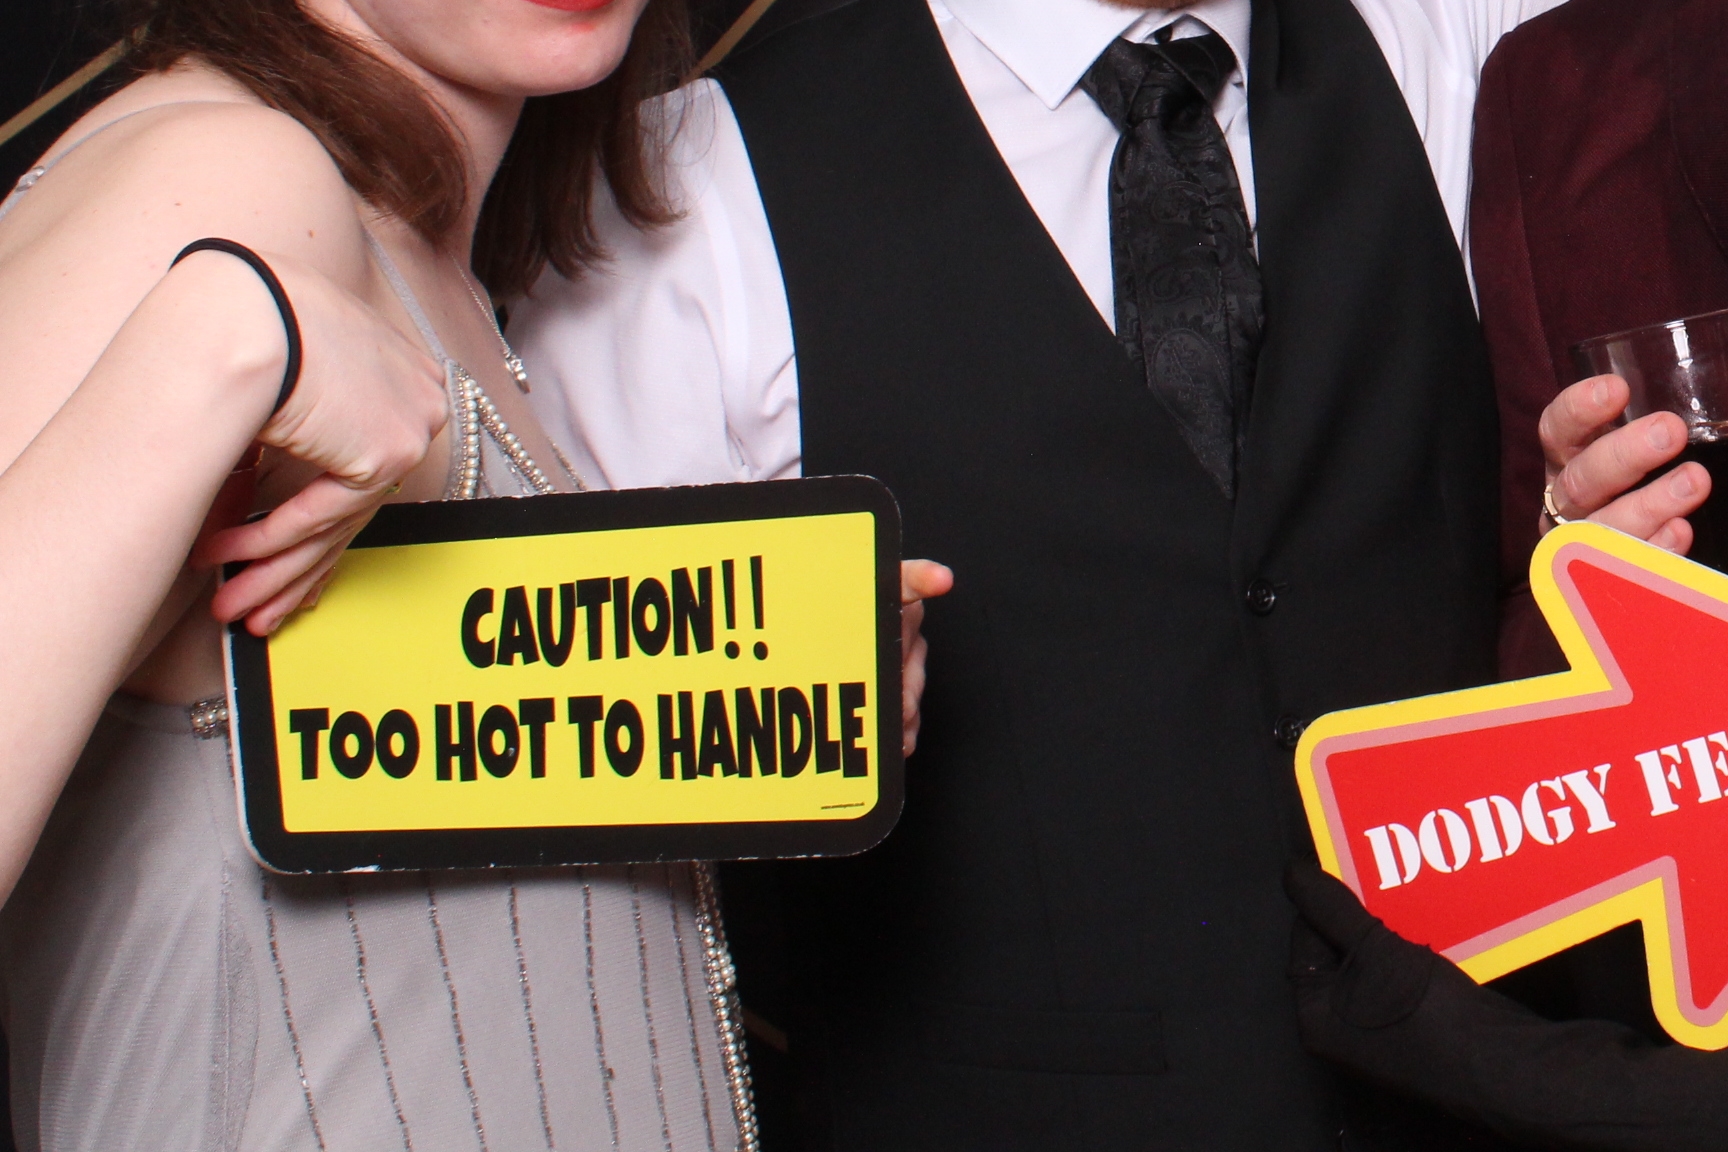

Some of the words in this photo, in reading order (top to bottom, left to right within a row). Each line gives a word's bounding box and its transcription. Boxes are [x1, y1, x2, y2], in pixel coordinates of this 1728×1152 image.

[461, 555, 769, 669] CAUTION!!
[289, 707, 420, 782] TOO
[435, 697, 555, 782] HOT
[568, 694, 645, 780] TO
[657, 682, 868, 781] HANDLE
[1363, 763, 1616, 890] DODGY
